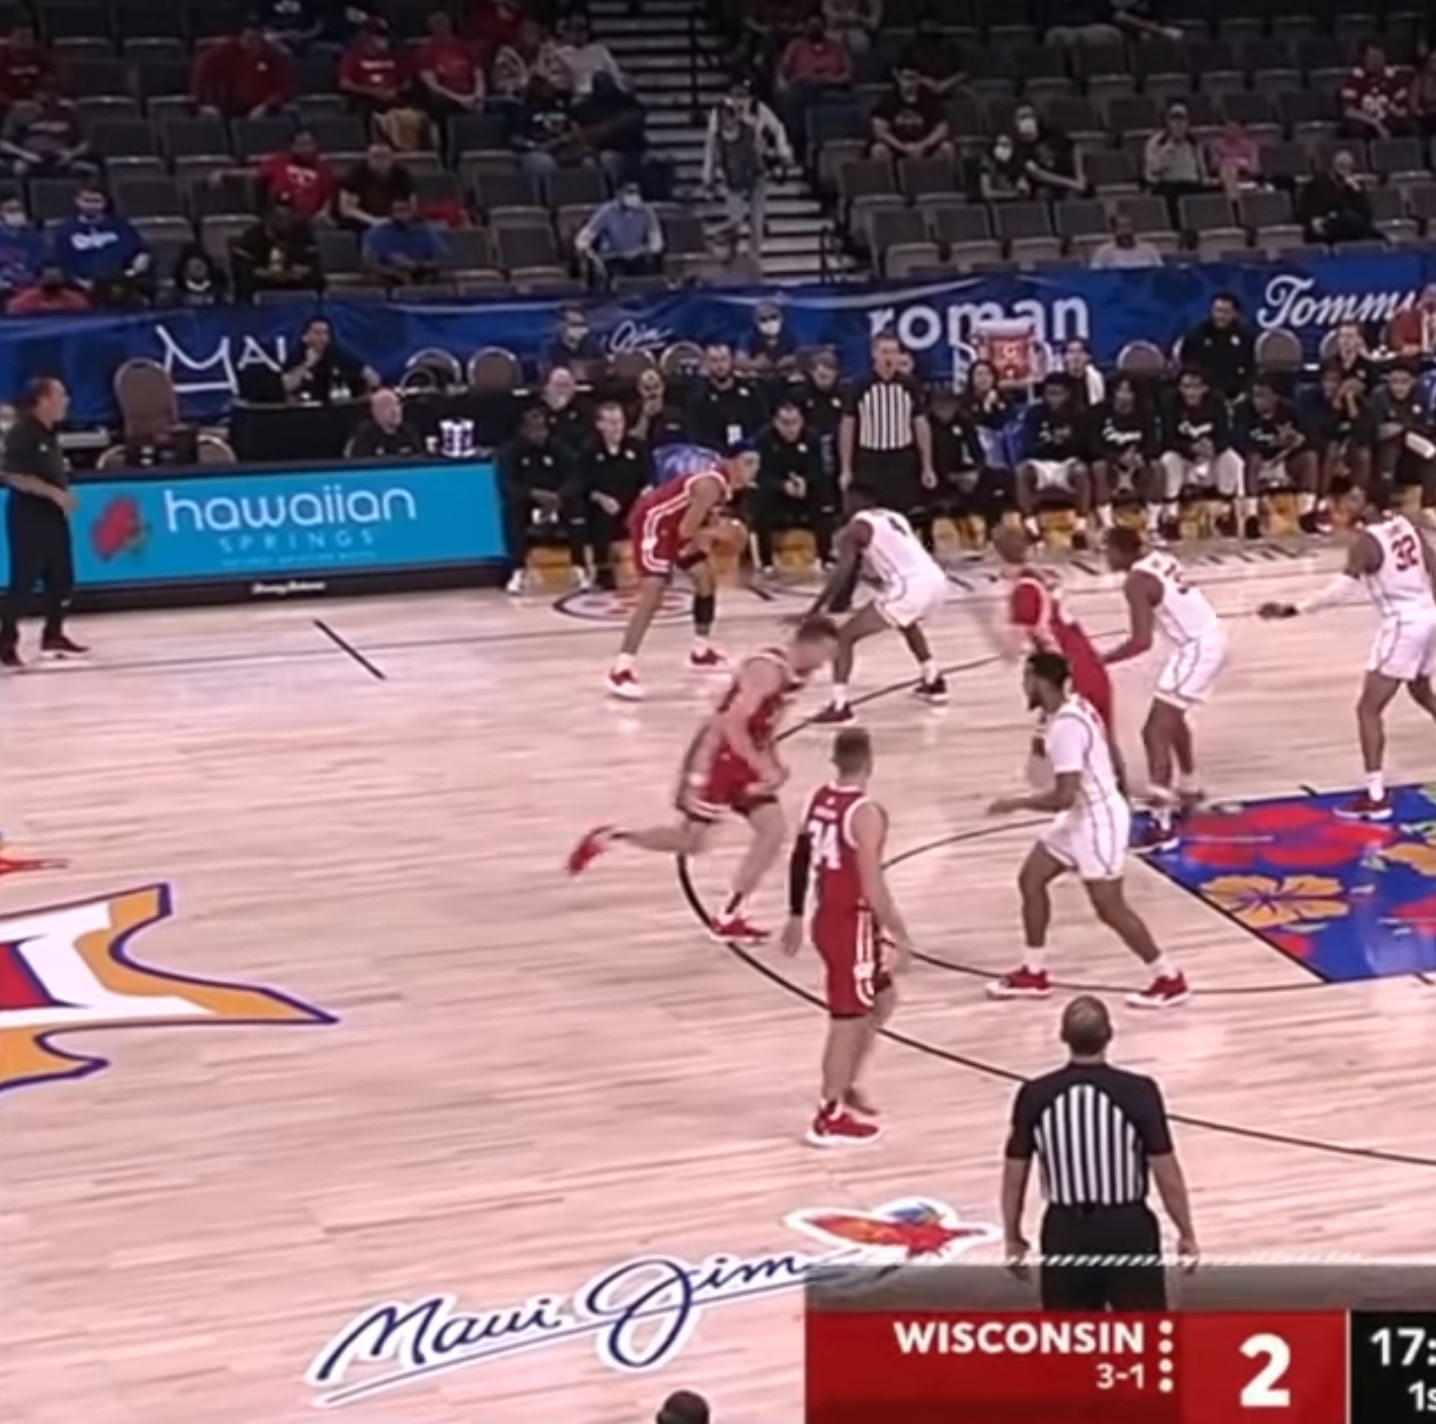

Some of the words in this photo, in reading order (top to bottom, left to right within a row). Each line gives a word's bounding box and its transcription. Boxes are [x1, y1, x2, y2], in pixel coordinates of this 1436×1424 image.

[867, 295, 1089, 349] roman
[1257, 275, 1416, 329] Tomm
[164, 485, 418, 533] hawaiian
[218, 527, 375, 555] SPRINGS
[315, 1297, 561, 1382] Maui
[586, 1255, 806, 1369] Jim
